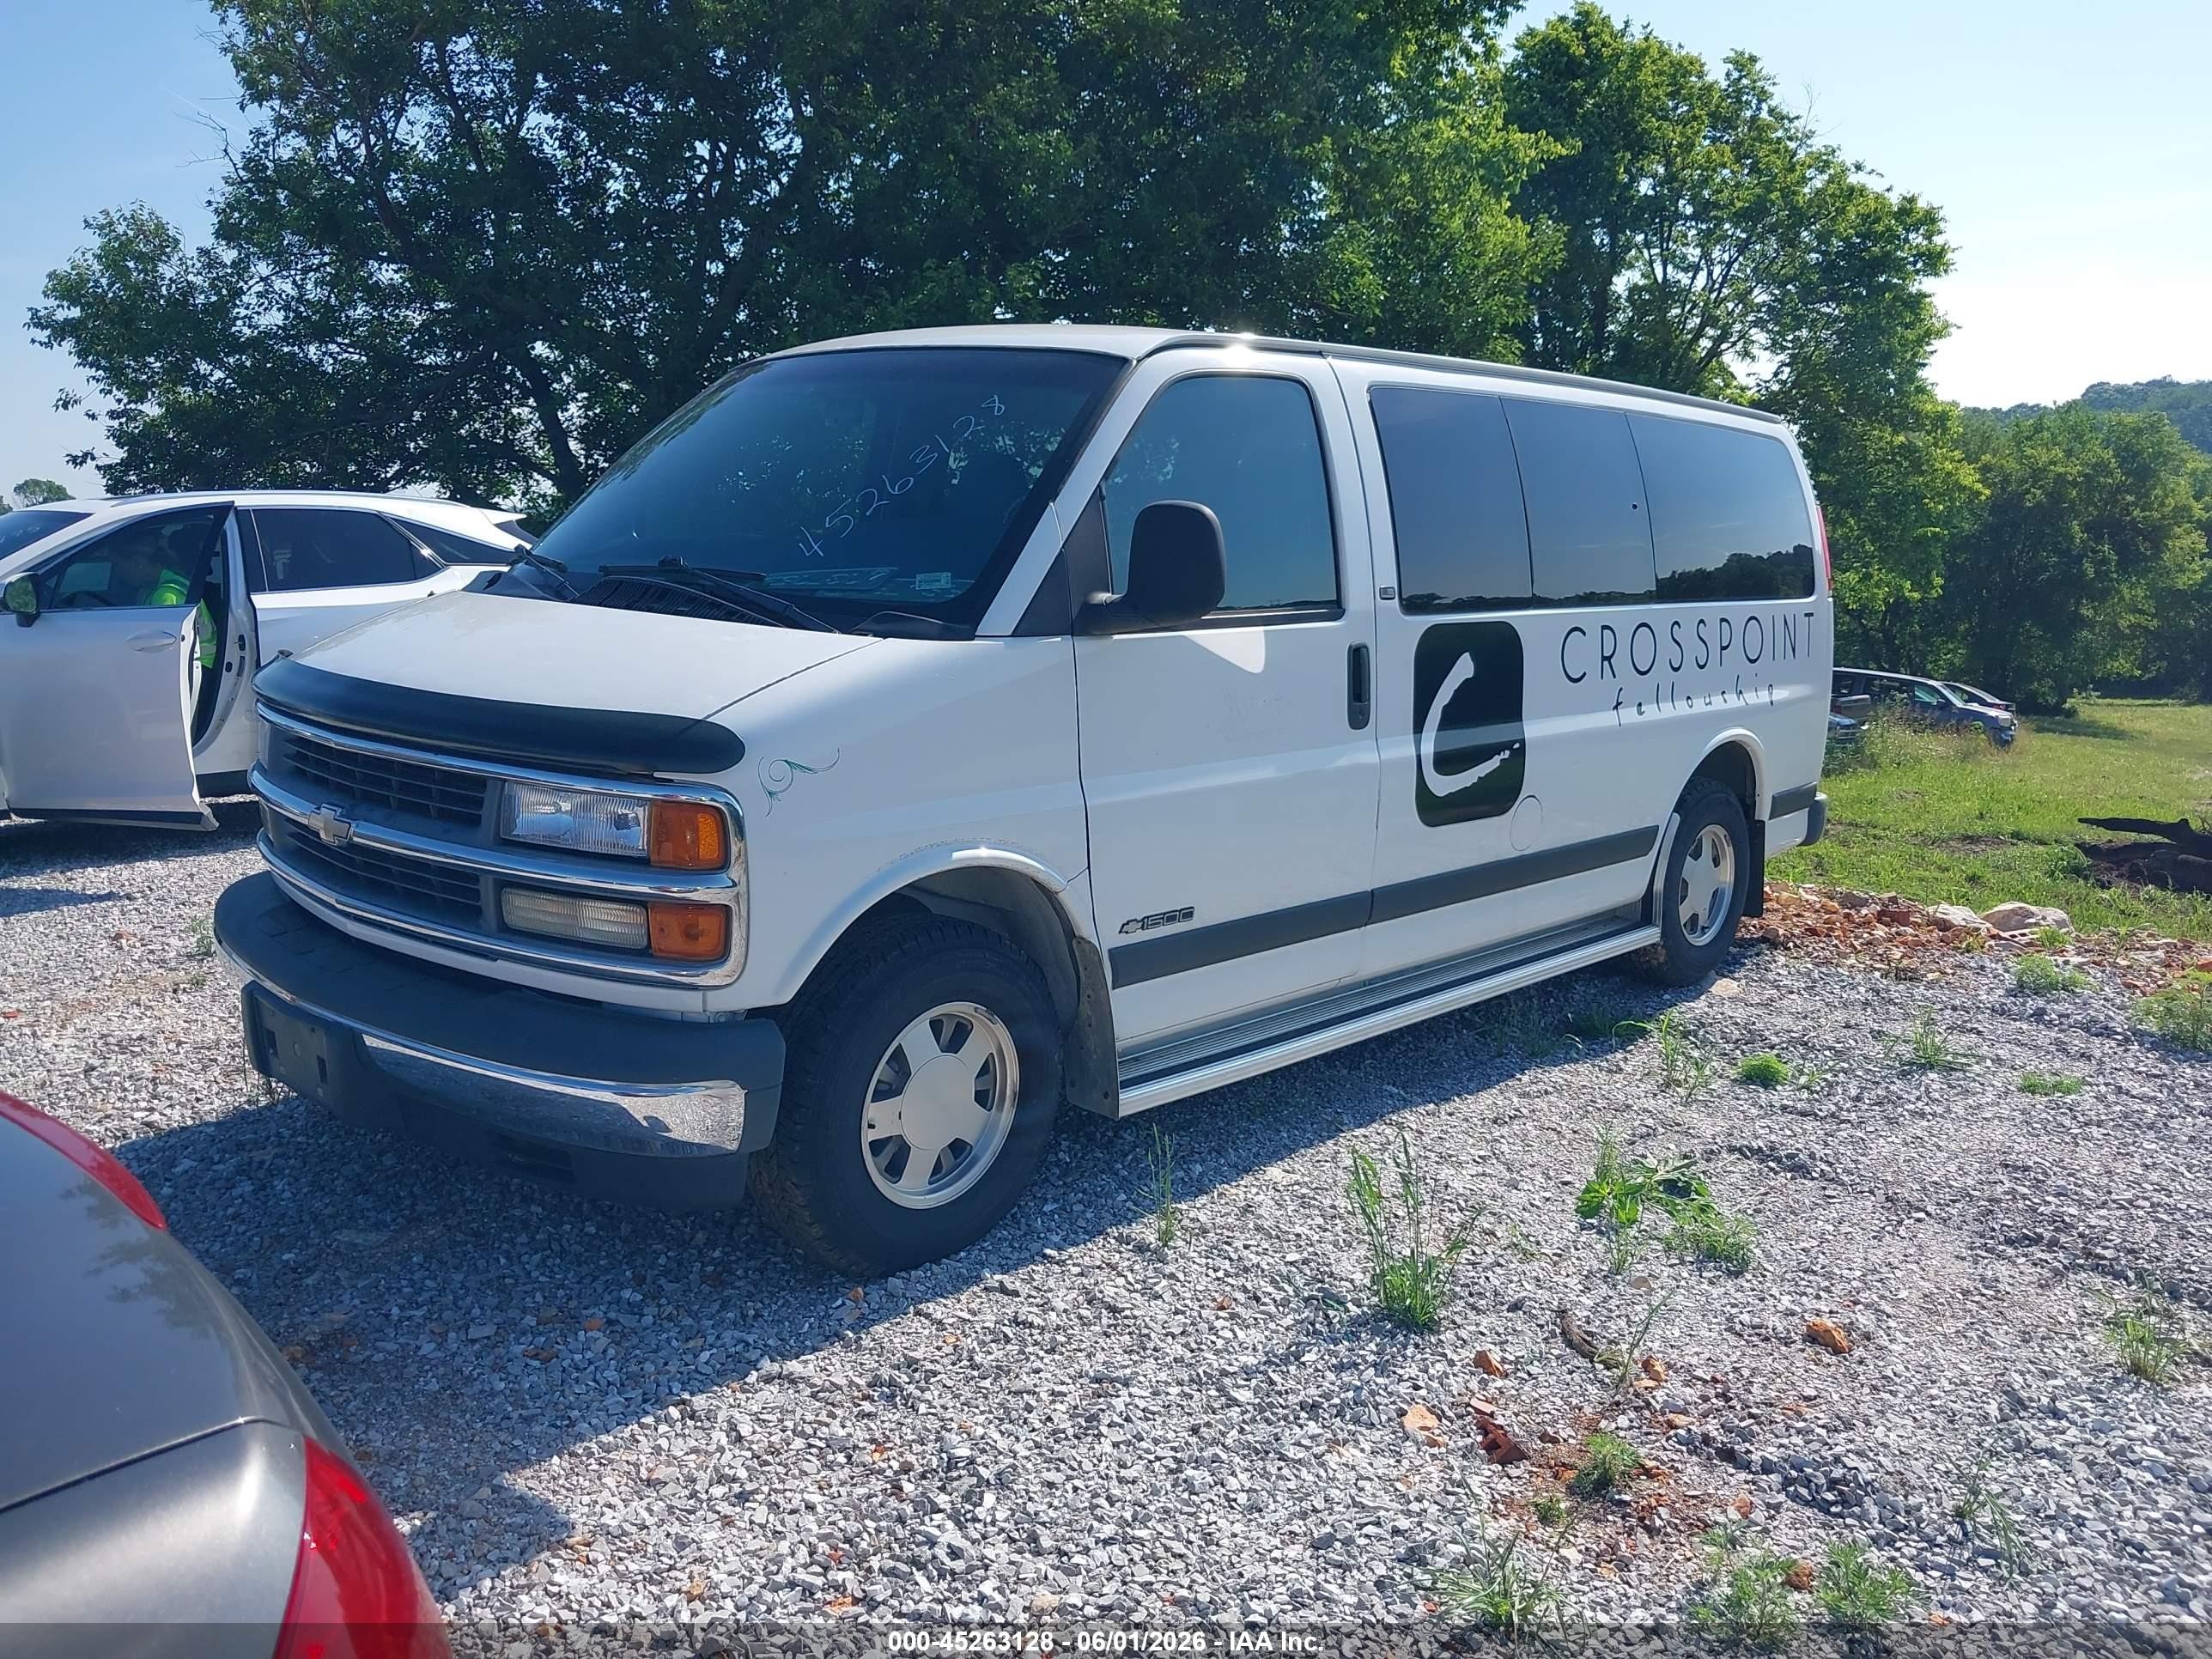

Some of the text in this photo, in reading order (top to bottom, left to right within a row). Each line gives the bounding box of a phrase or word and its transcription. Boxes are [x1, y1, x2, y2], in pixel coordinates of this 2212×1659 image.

[798, 395, 1005, 557] 45263128
[1561, 612, 1814, 684] CROSSPOINT
[1141, 906, 1194, 931] 1500
